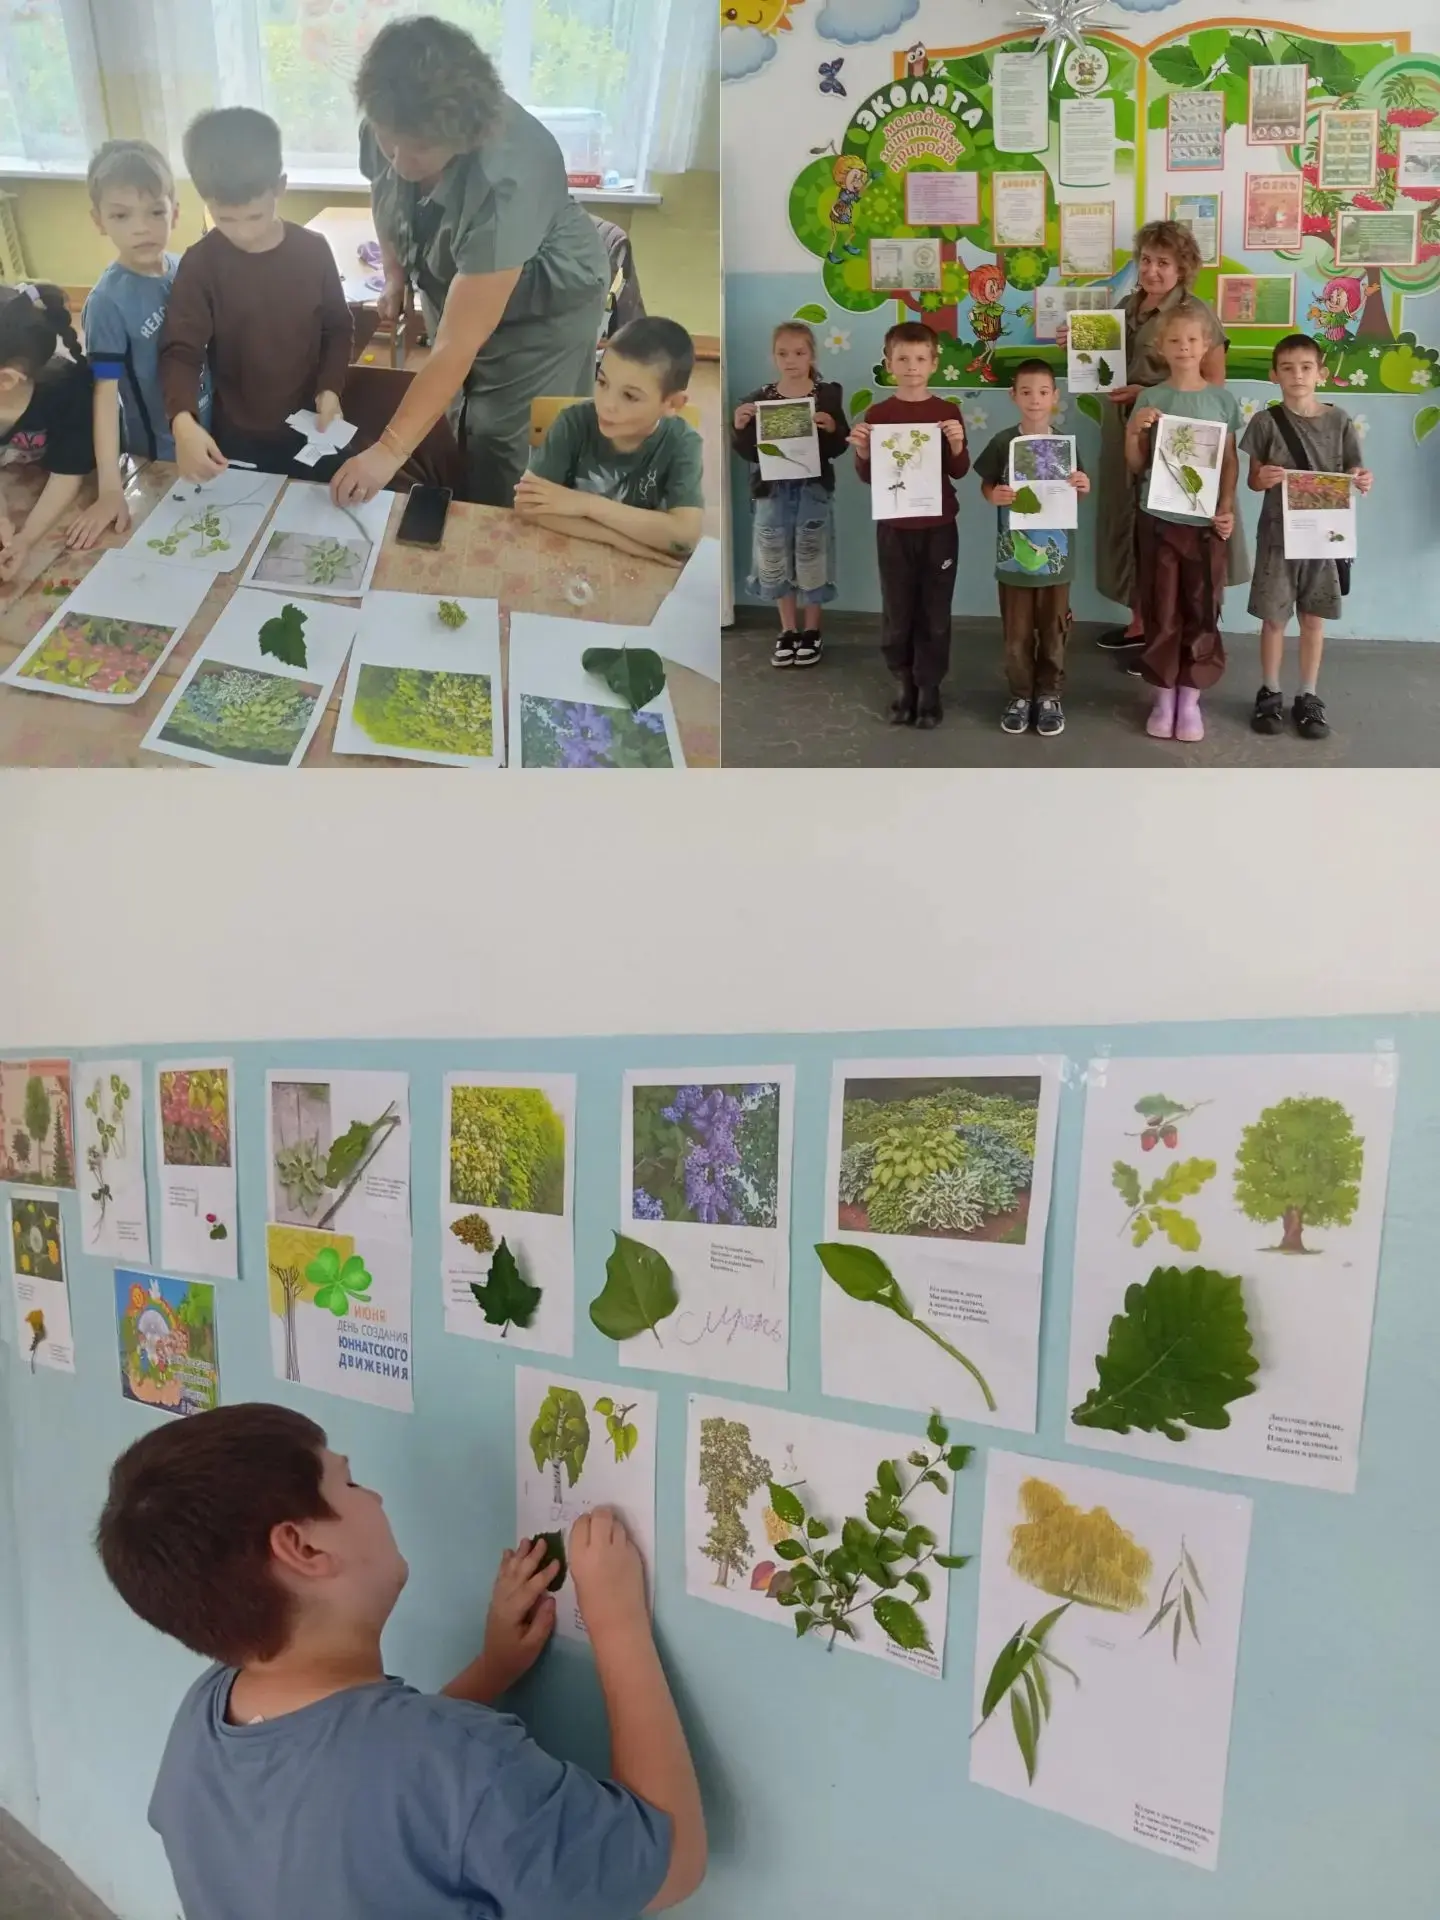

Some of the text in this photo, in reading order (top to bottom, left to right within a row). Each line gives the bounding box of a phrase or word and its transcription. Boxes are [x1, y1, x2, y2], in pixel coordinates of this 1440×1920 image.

[856, 81, 983, 132] ЭКОЛЯТА
[883, 106, 956, 138] молодые
[880, 125, 966, 162] защитники
[890, 141, 958, 173] природы
[354, 1305, 387, 1322] ИЮНЯ
[337, 1319, 408, 1344] ДЕНЬ СОЗДАНИЯ
[338, 1335, 408, 1362] ЮННАТСКОГО
[338, 1353, 408, 1380] ДВИЖЕНИЯ
